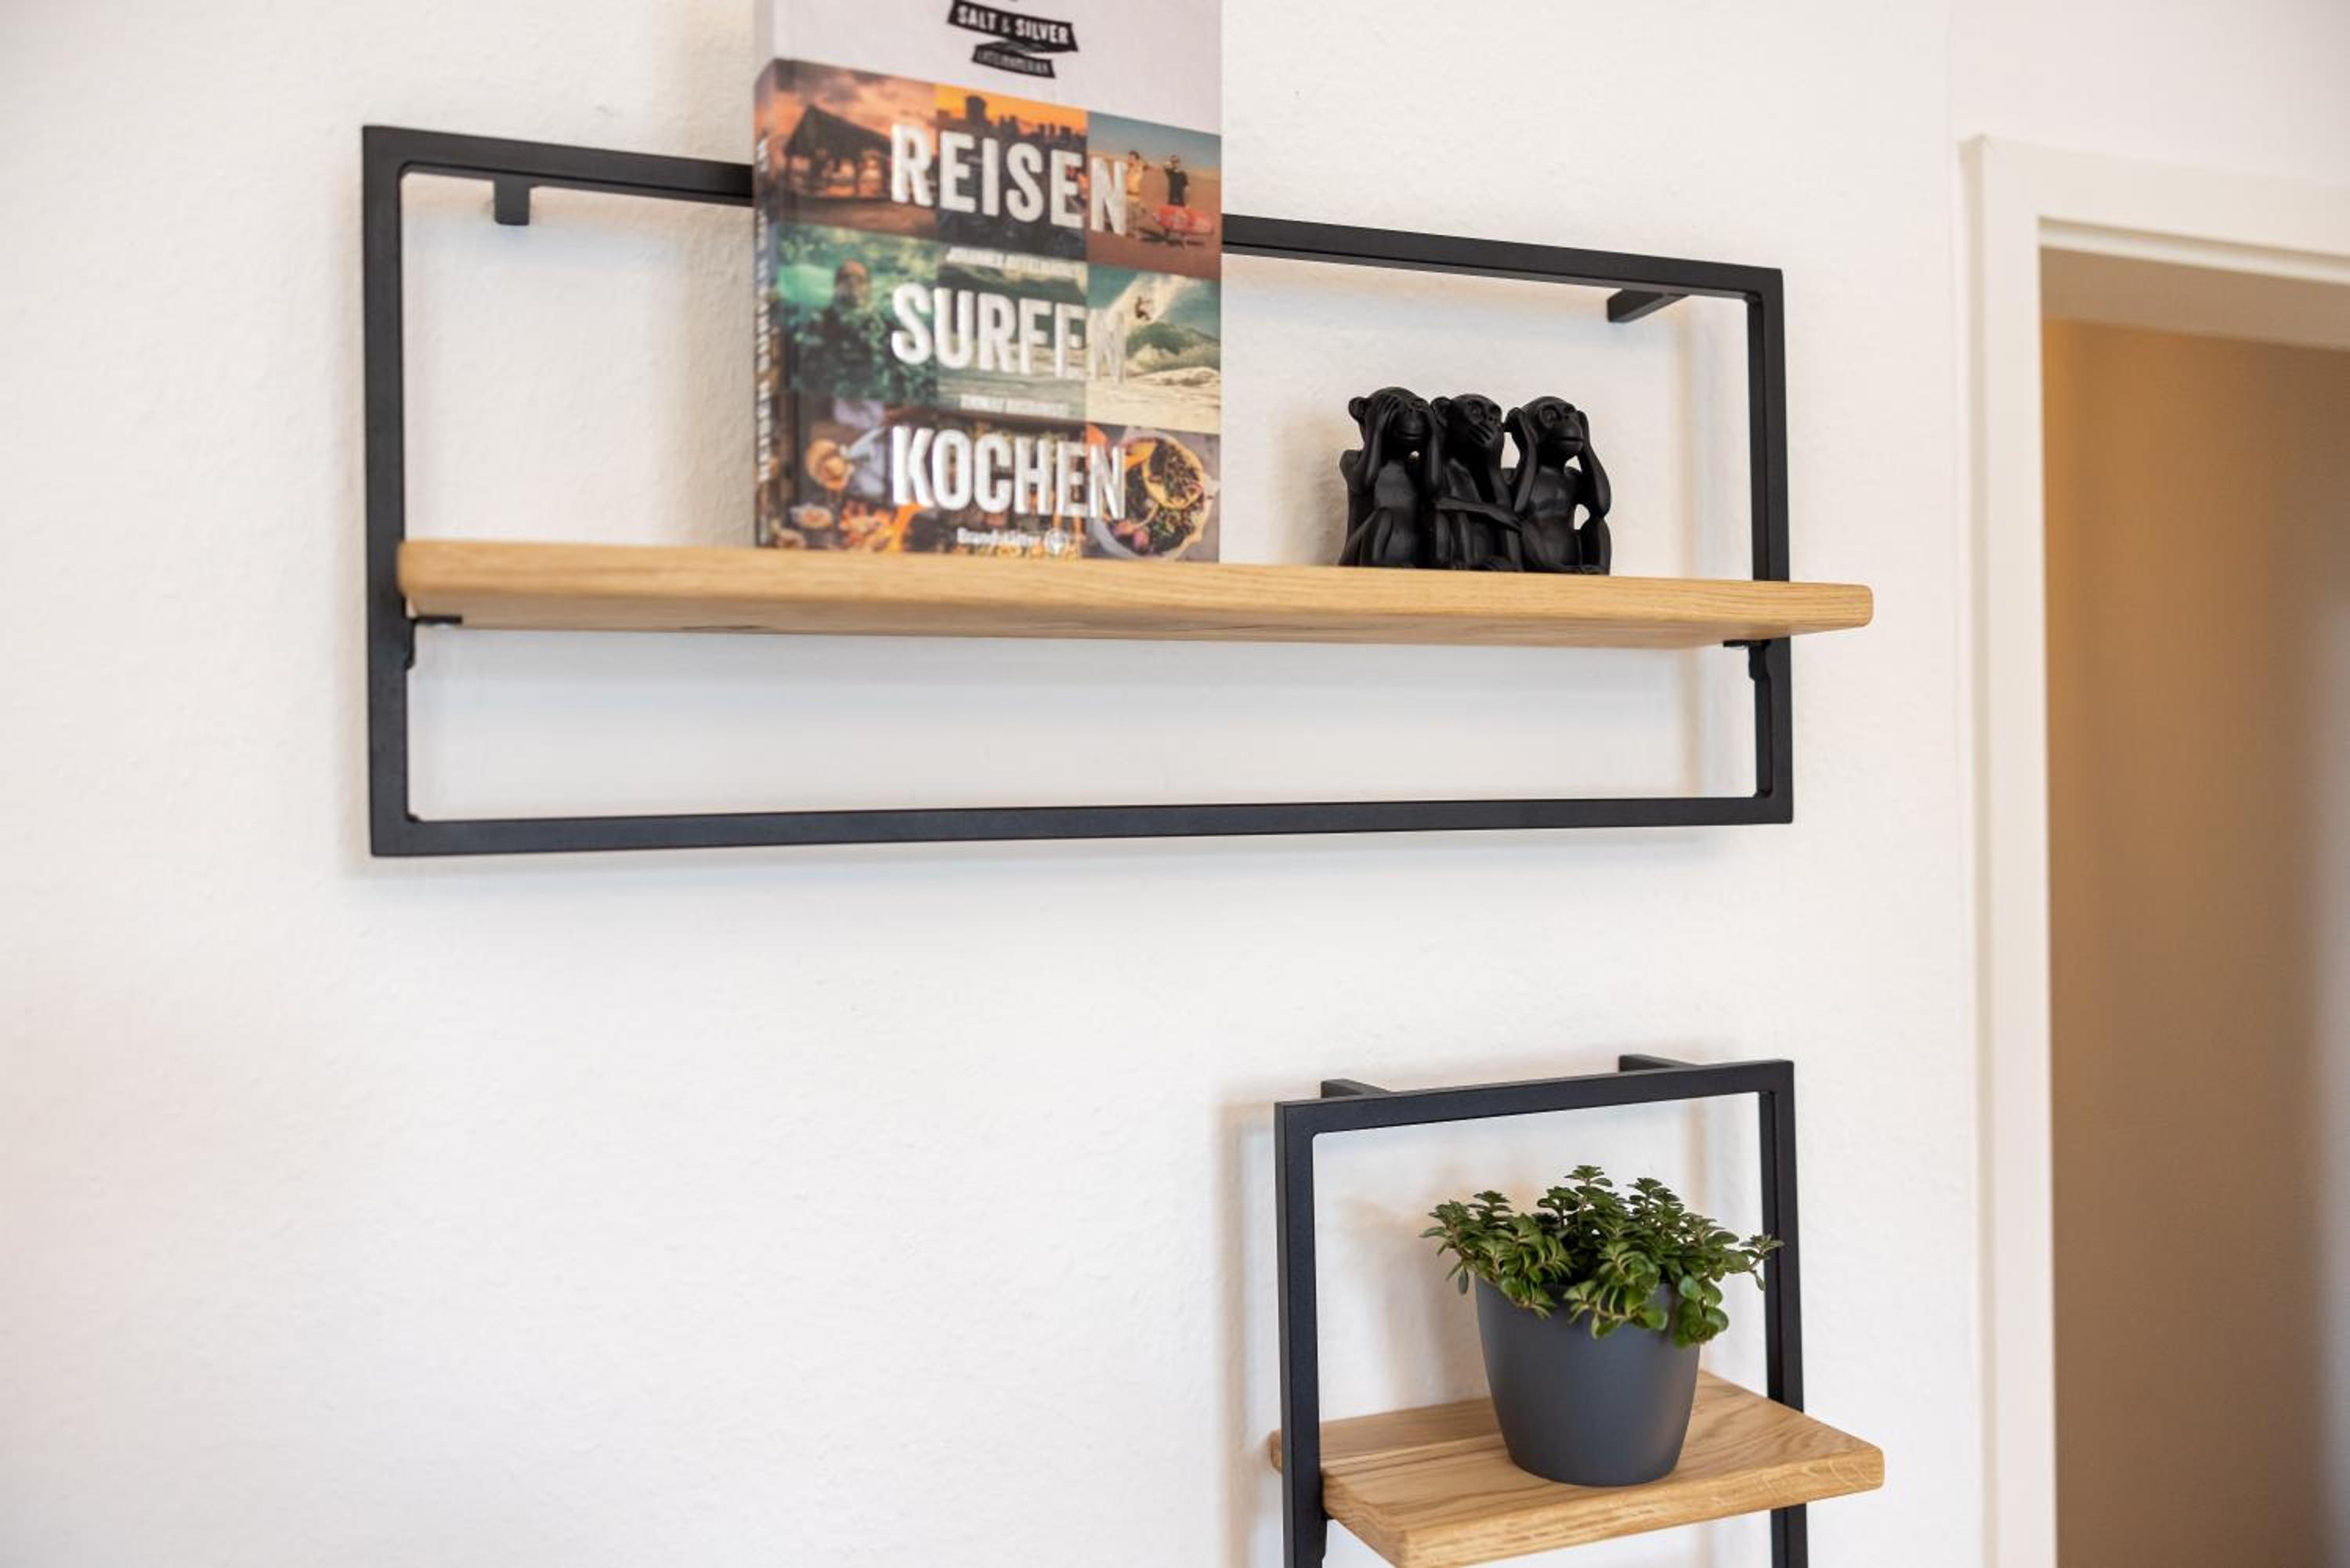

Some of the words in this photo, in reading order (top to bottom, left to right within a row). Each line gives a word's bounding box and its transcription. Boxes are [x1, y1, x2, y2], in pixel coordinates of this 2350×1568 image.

[956, 5, 998, 31] SALT
[1001, 16, 1010, 33] &
[1015, 18, 1068, 45] SILVER
[891, 124, 1128, 237] REISEN
[891, 282, 1127, 384] SURFEN
[891, 424, 1126, 520] KOCHEN
